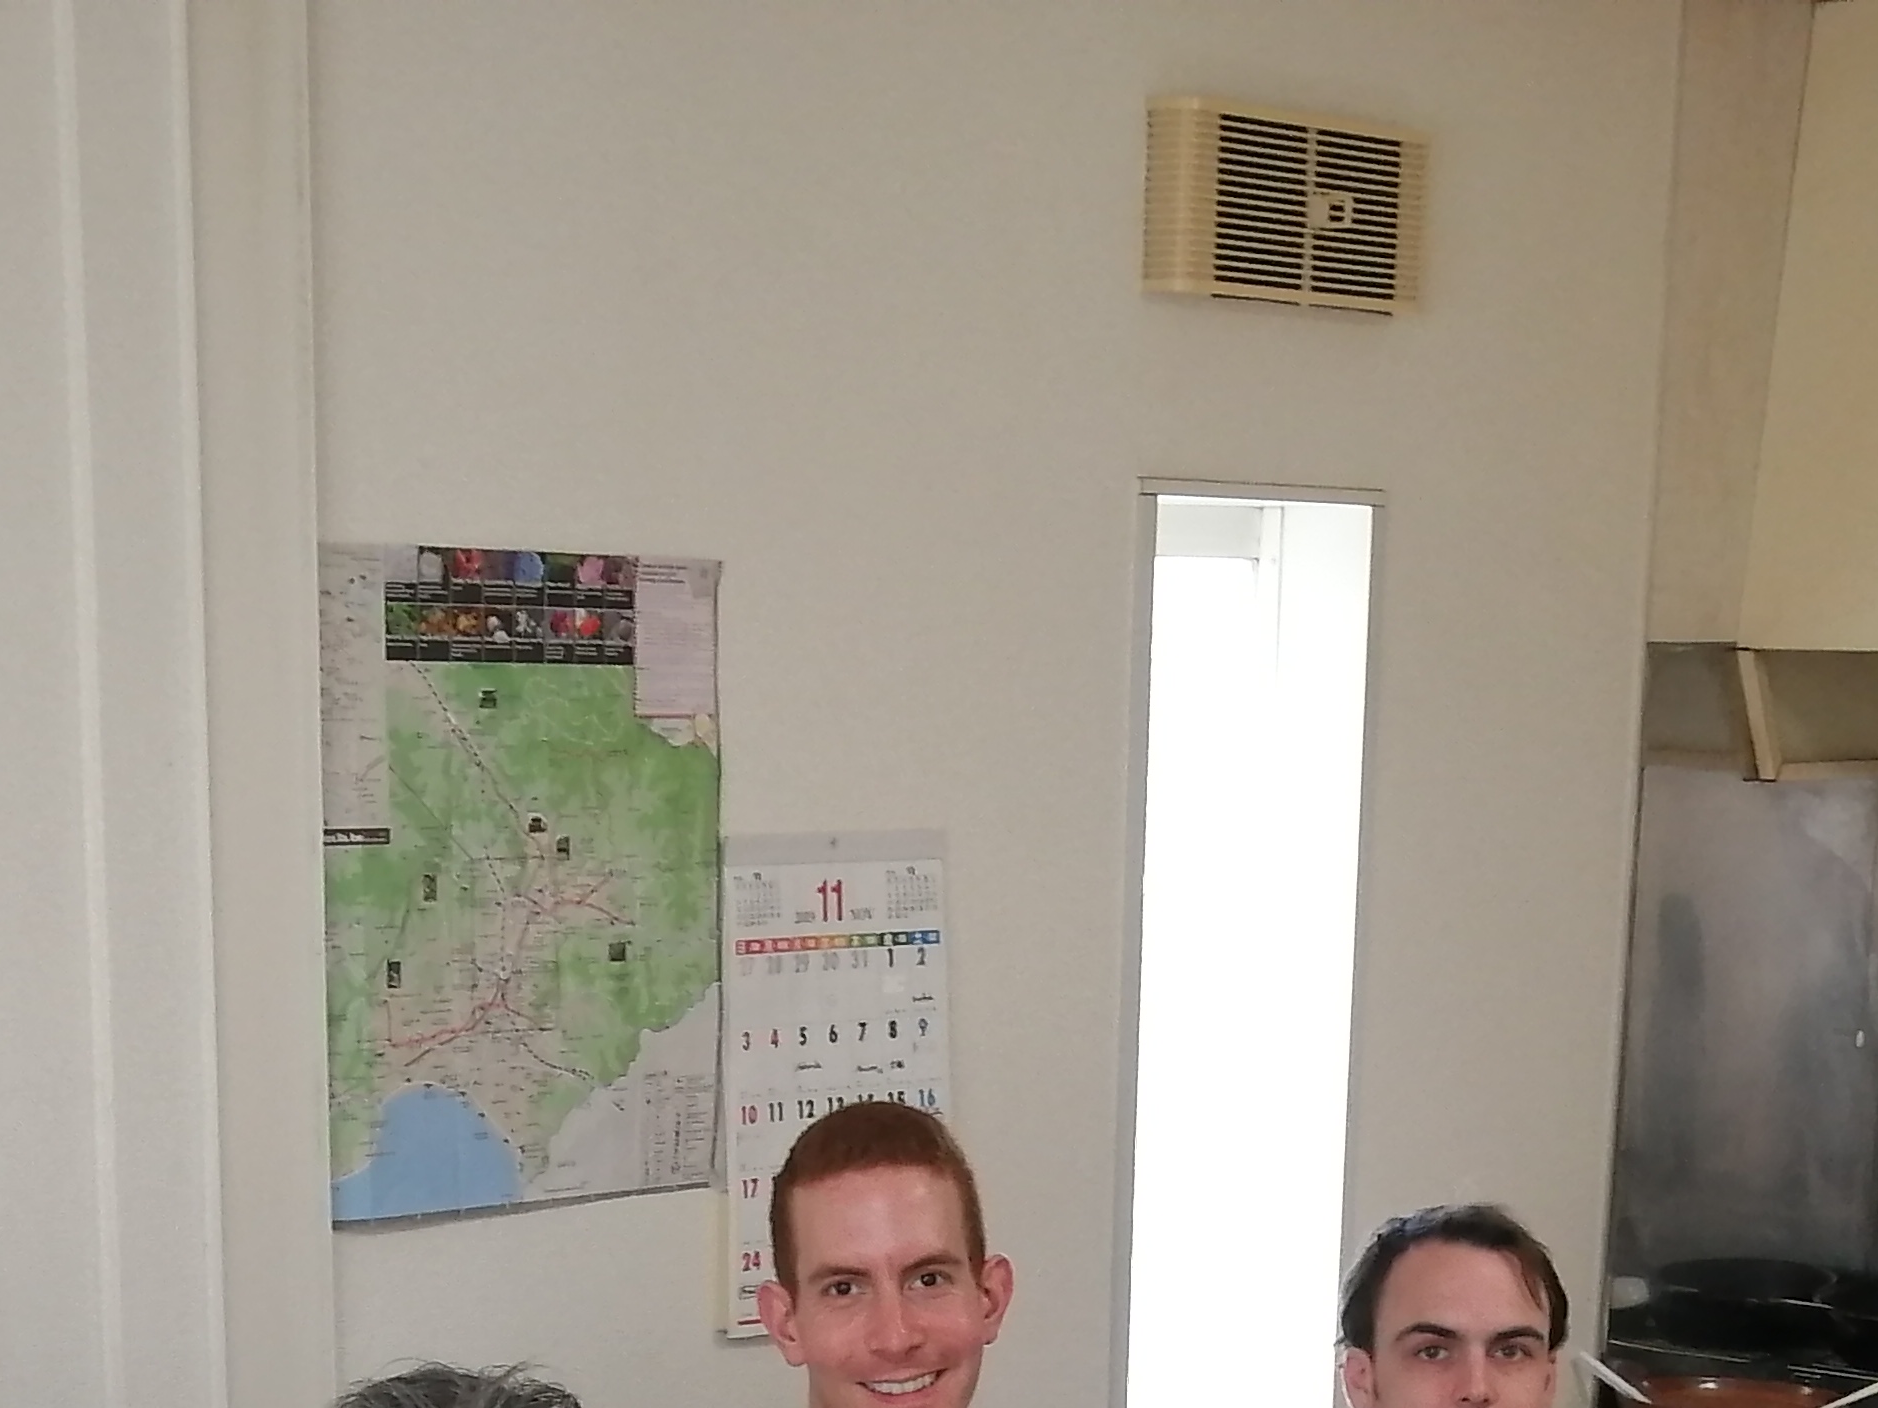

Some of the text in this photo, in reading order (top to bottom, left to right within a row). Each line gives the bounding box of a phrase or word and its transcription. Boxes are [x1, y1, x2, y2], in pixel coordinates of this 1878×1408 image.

[816, 879, 843, 923] 11
[886, 948, 894, 968] 1
[916, 946, 927, 966] 2
[741, 1017, 929, 1051] 3 4 5 6 7 8 9
[741, 1105, 758, 1125] 10
[768, 1101, 784, 1122] 11
[797, 1099, 815, 1119] 12
[918, 1088, 935, 1107] 16
[741, 1178, 759, 1199] 17
[741, 1251, 761, 1272] 24
